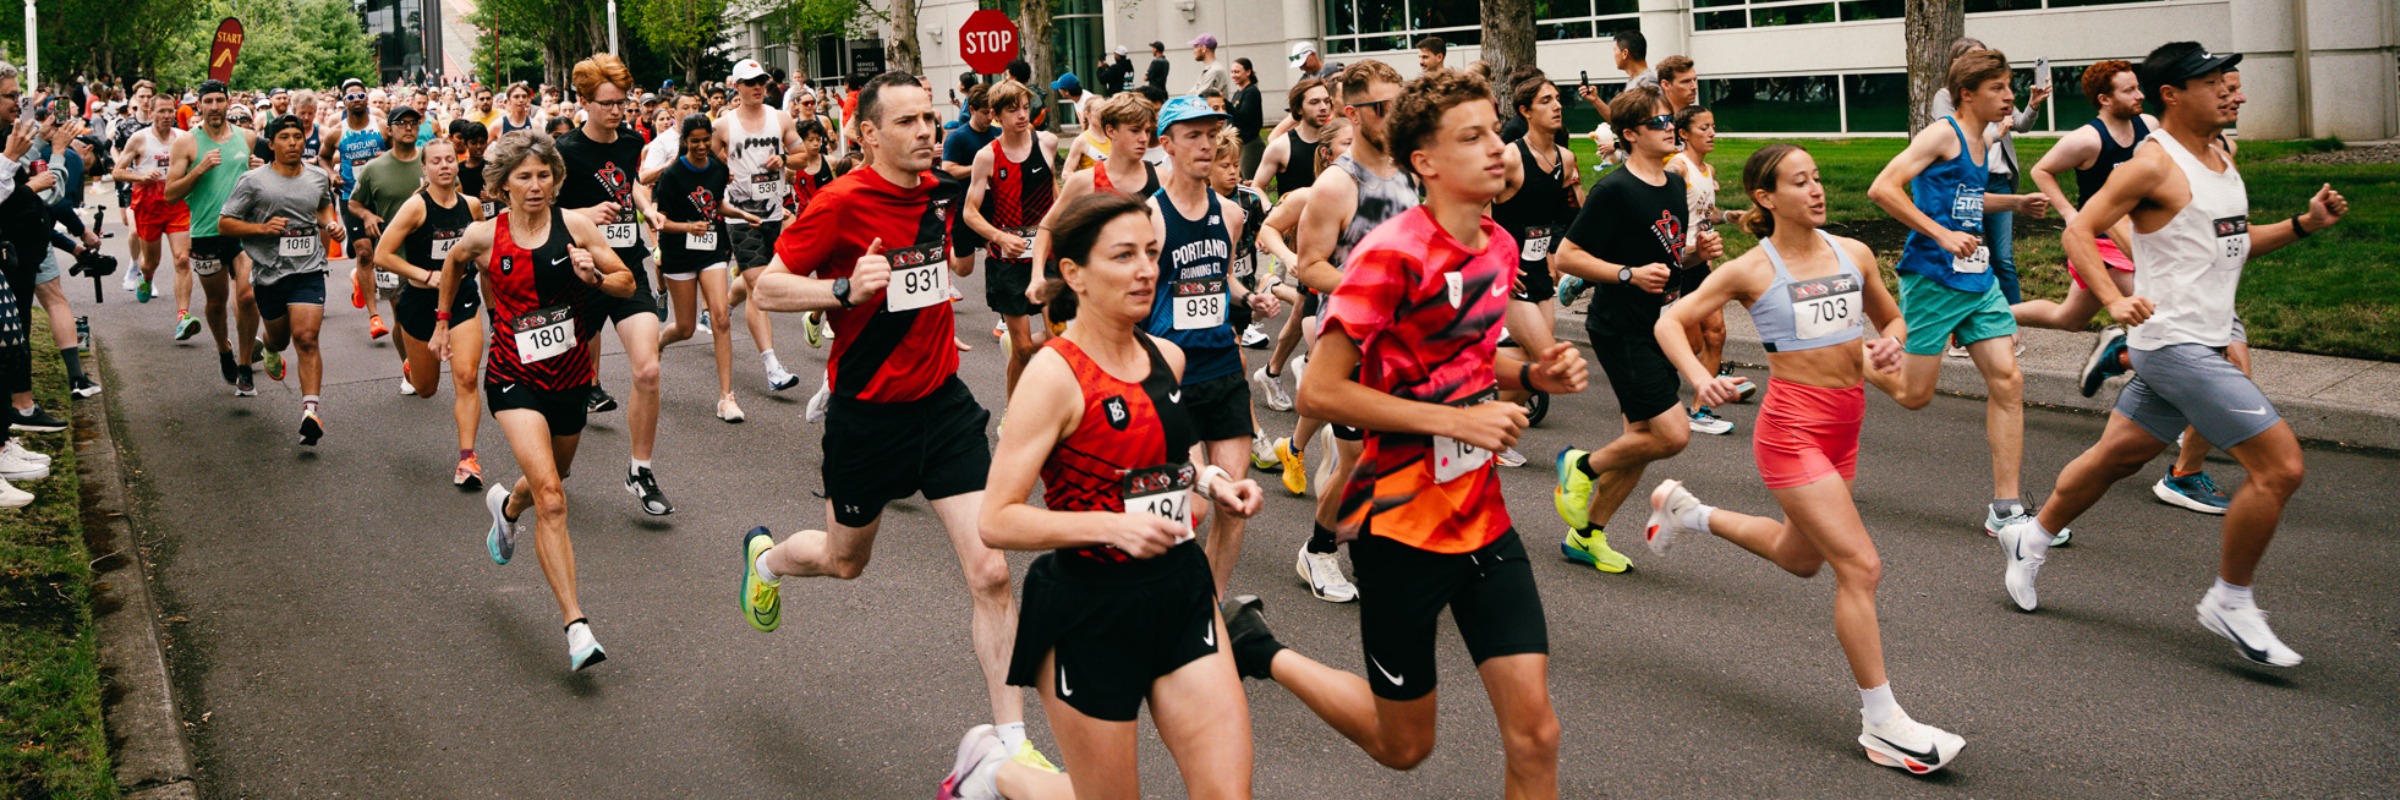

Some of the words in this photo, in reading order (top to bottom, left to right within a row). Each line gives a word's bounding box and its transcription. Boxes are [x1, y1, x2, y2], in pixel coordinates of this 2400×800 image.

[217, 32, 243, 44] START
[966, 30, 1012, 54] STOP
[346, 140, 378, 152] PORTLAND
[758, 181, 777, 194] 539
[606, 225, 631, 240] 545
[286, 237, 310, 250] 1016
[1172, 239, 1228, 269] PORTLAND
[196, 260, 213, 270] 847
[1181, 263, 1212, 280] RUNNING
[905, 266, 939, 294] 931
[1186, 297, 1218, 318] 938
[1809, 297, 1848, 324] 703
[530, 325, 566, 350] 180
